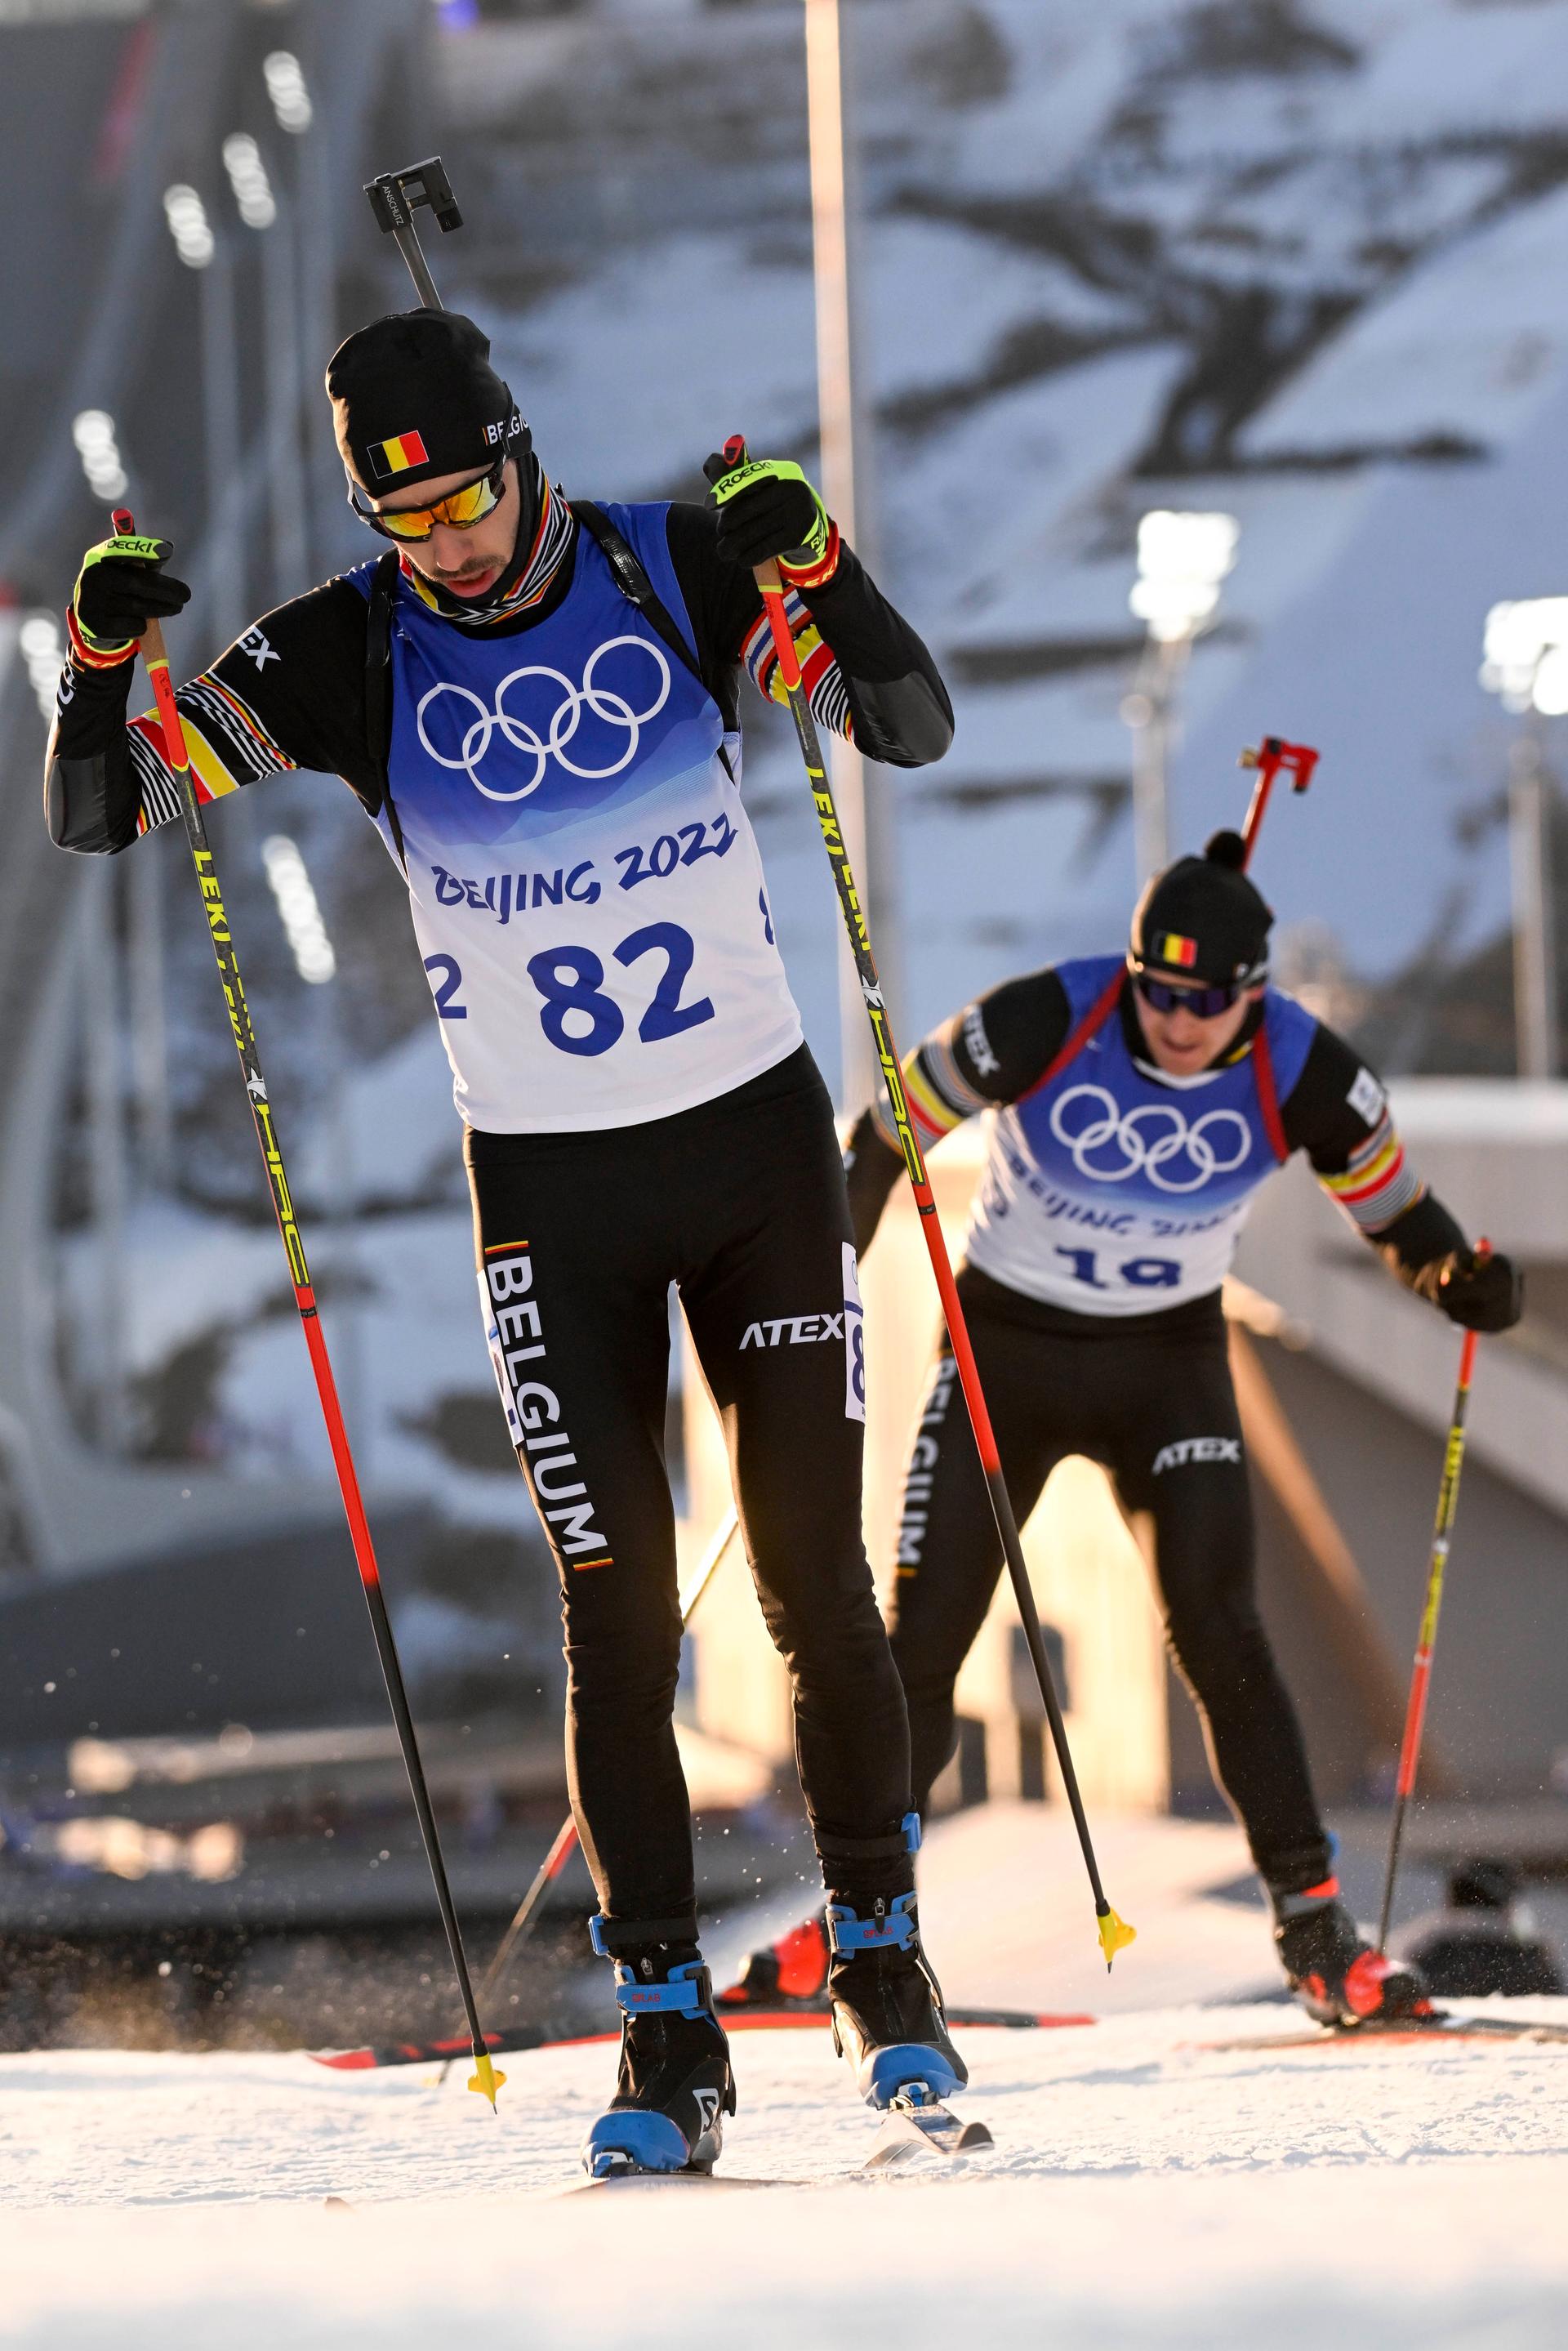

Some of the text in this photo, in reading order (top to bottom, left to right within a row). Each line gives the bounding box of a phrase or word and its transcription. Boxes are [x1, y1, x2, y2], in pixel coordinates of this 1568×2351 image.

[806, 766, 844, 855] LEKI
[193, 850, 232, 942] LEKI
[430, 812, 739, 925] BEIJING 2022
[526, 921, 715, 1057] 82
[255, 1103, 310, 1285] HRC
[738, 1312, 845, 1350] ATEX
[487, 1256, 608, 1555] BELGIUM
[1152, 1436, 1241, 1476] ATEX
